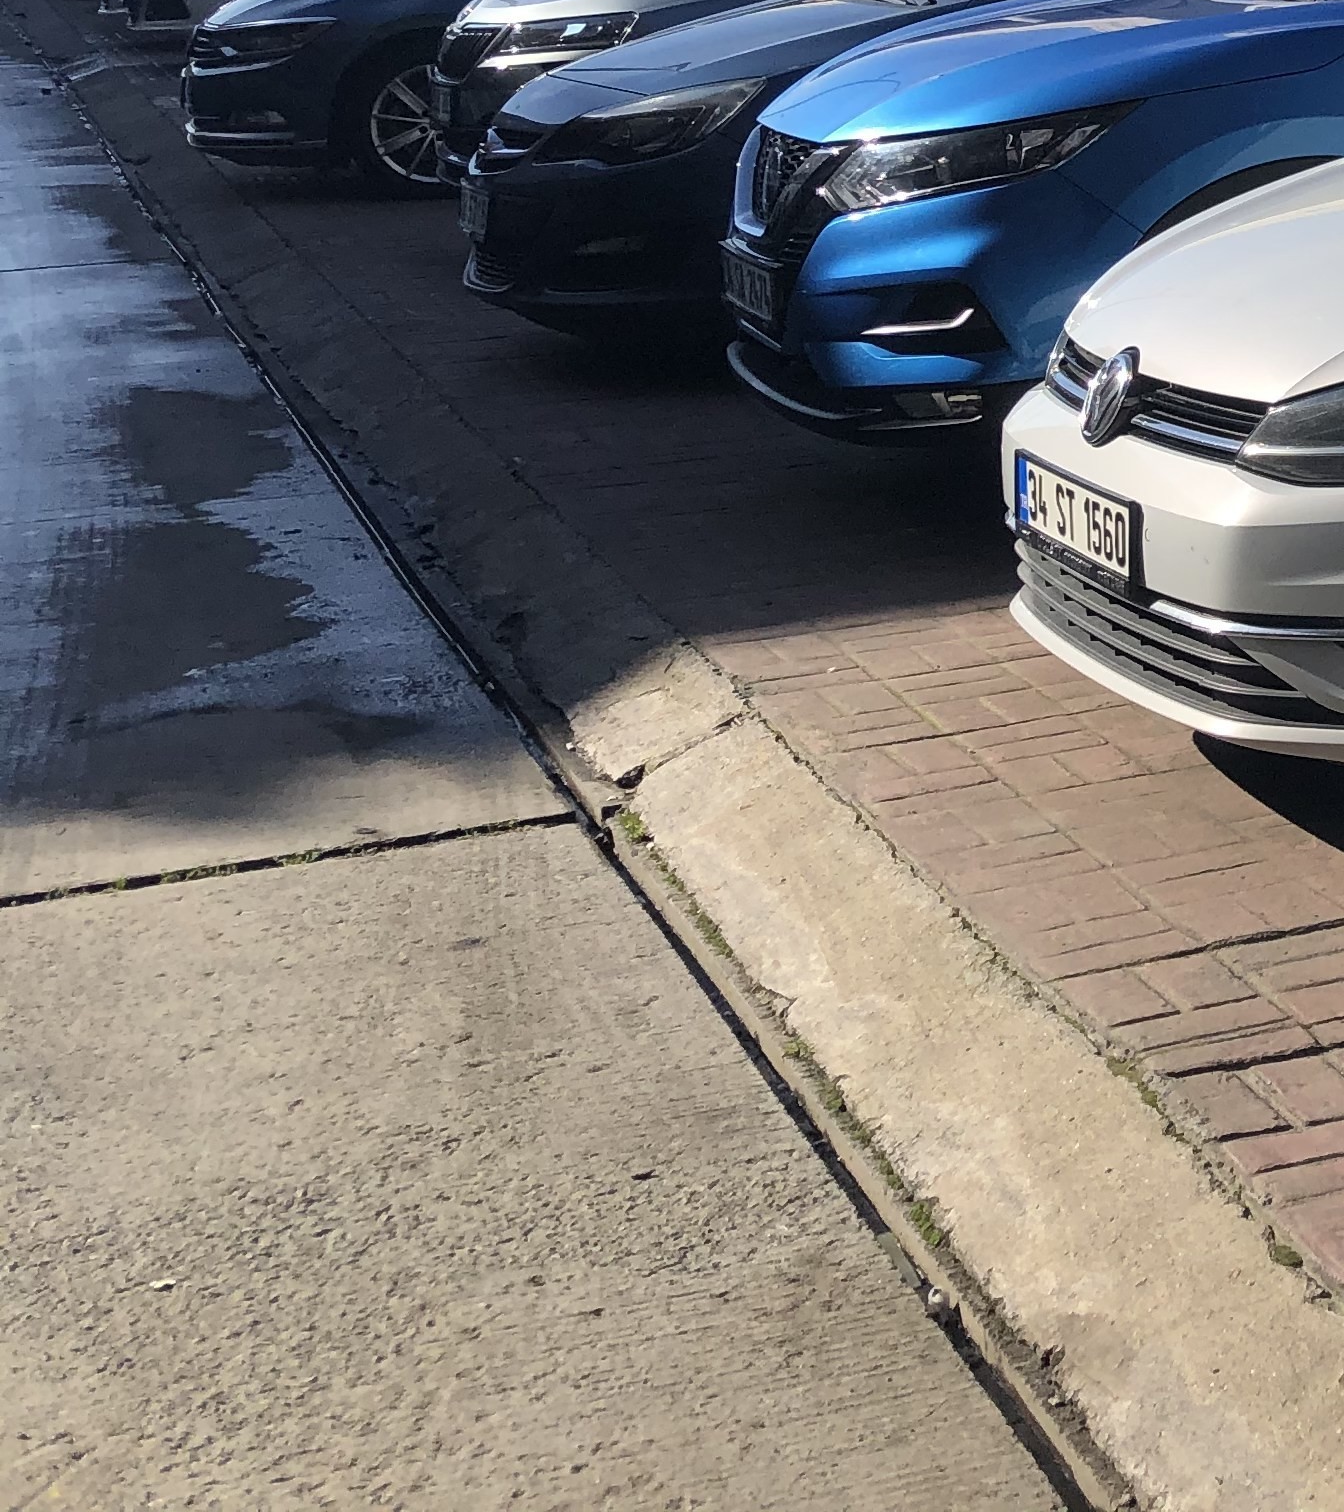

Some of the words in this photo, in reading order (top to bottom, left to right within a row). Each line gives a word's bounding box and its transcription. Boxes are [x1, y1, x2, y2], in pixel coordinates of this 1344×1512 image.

[1028, 469, 1047, 527] 34
[1055, 483, 1075, 542] ST
[1083, 497, 1126, 568] 1560
